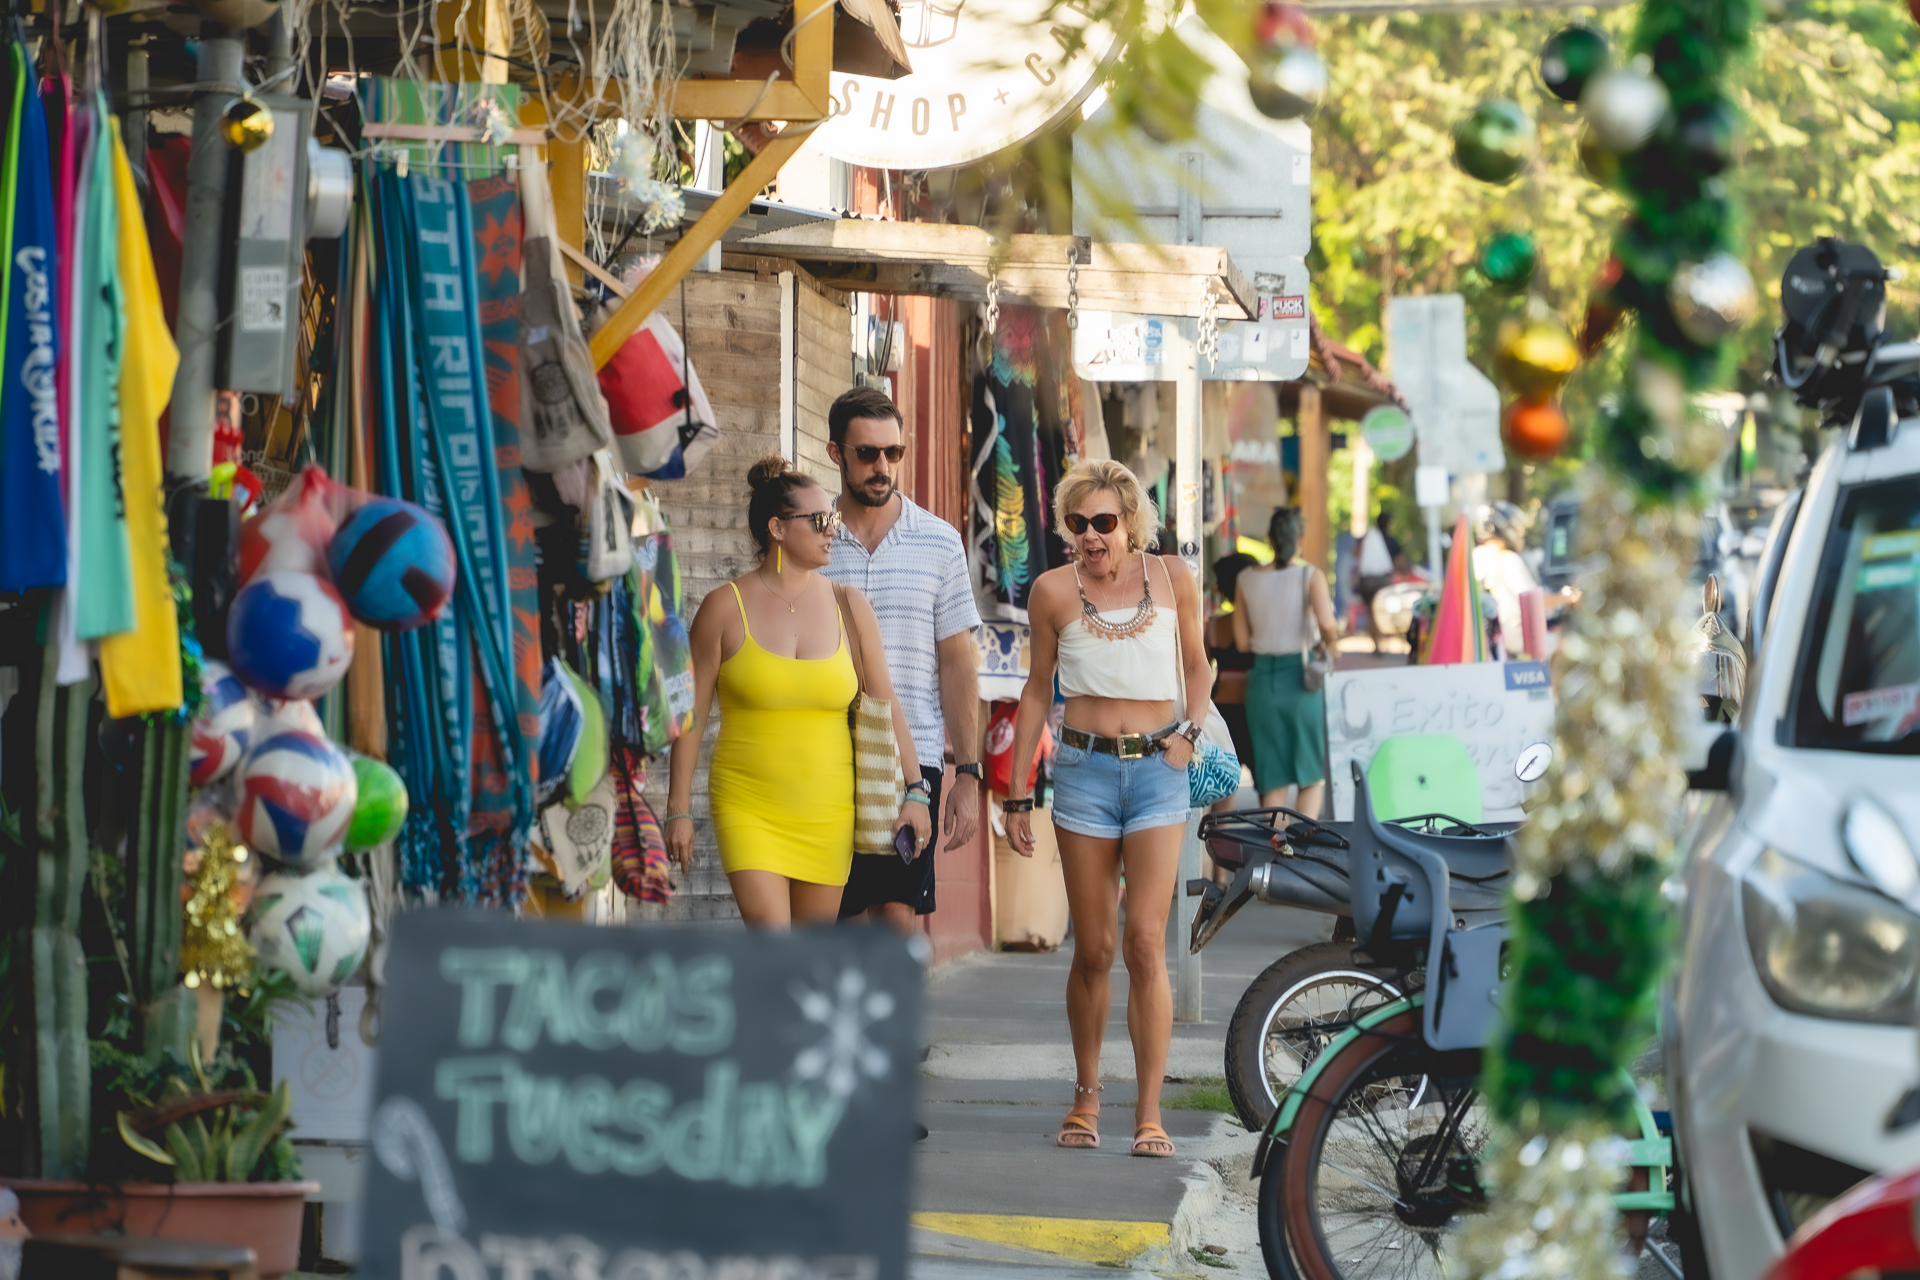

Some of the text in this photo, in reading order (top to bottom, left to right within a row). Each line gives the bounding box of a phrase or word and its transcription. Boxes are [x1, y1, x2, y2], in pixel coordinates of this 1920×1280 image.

[838, 79, 967, 136] SHOP
[1273, 299, 1303, 310] FUCK
[1512, 670, 1546, 685] VISA
[1390, 691, 1505, 734] Exito
[439, 946, 737, 1055] TACOS
